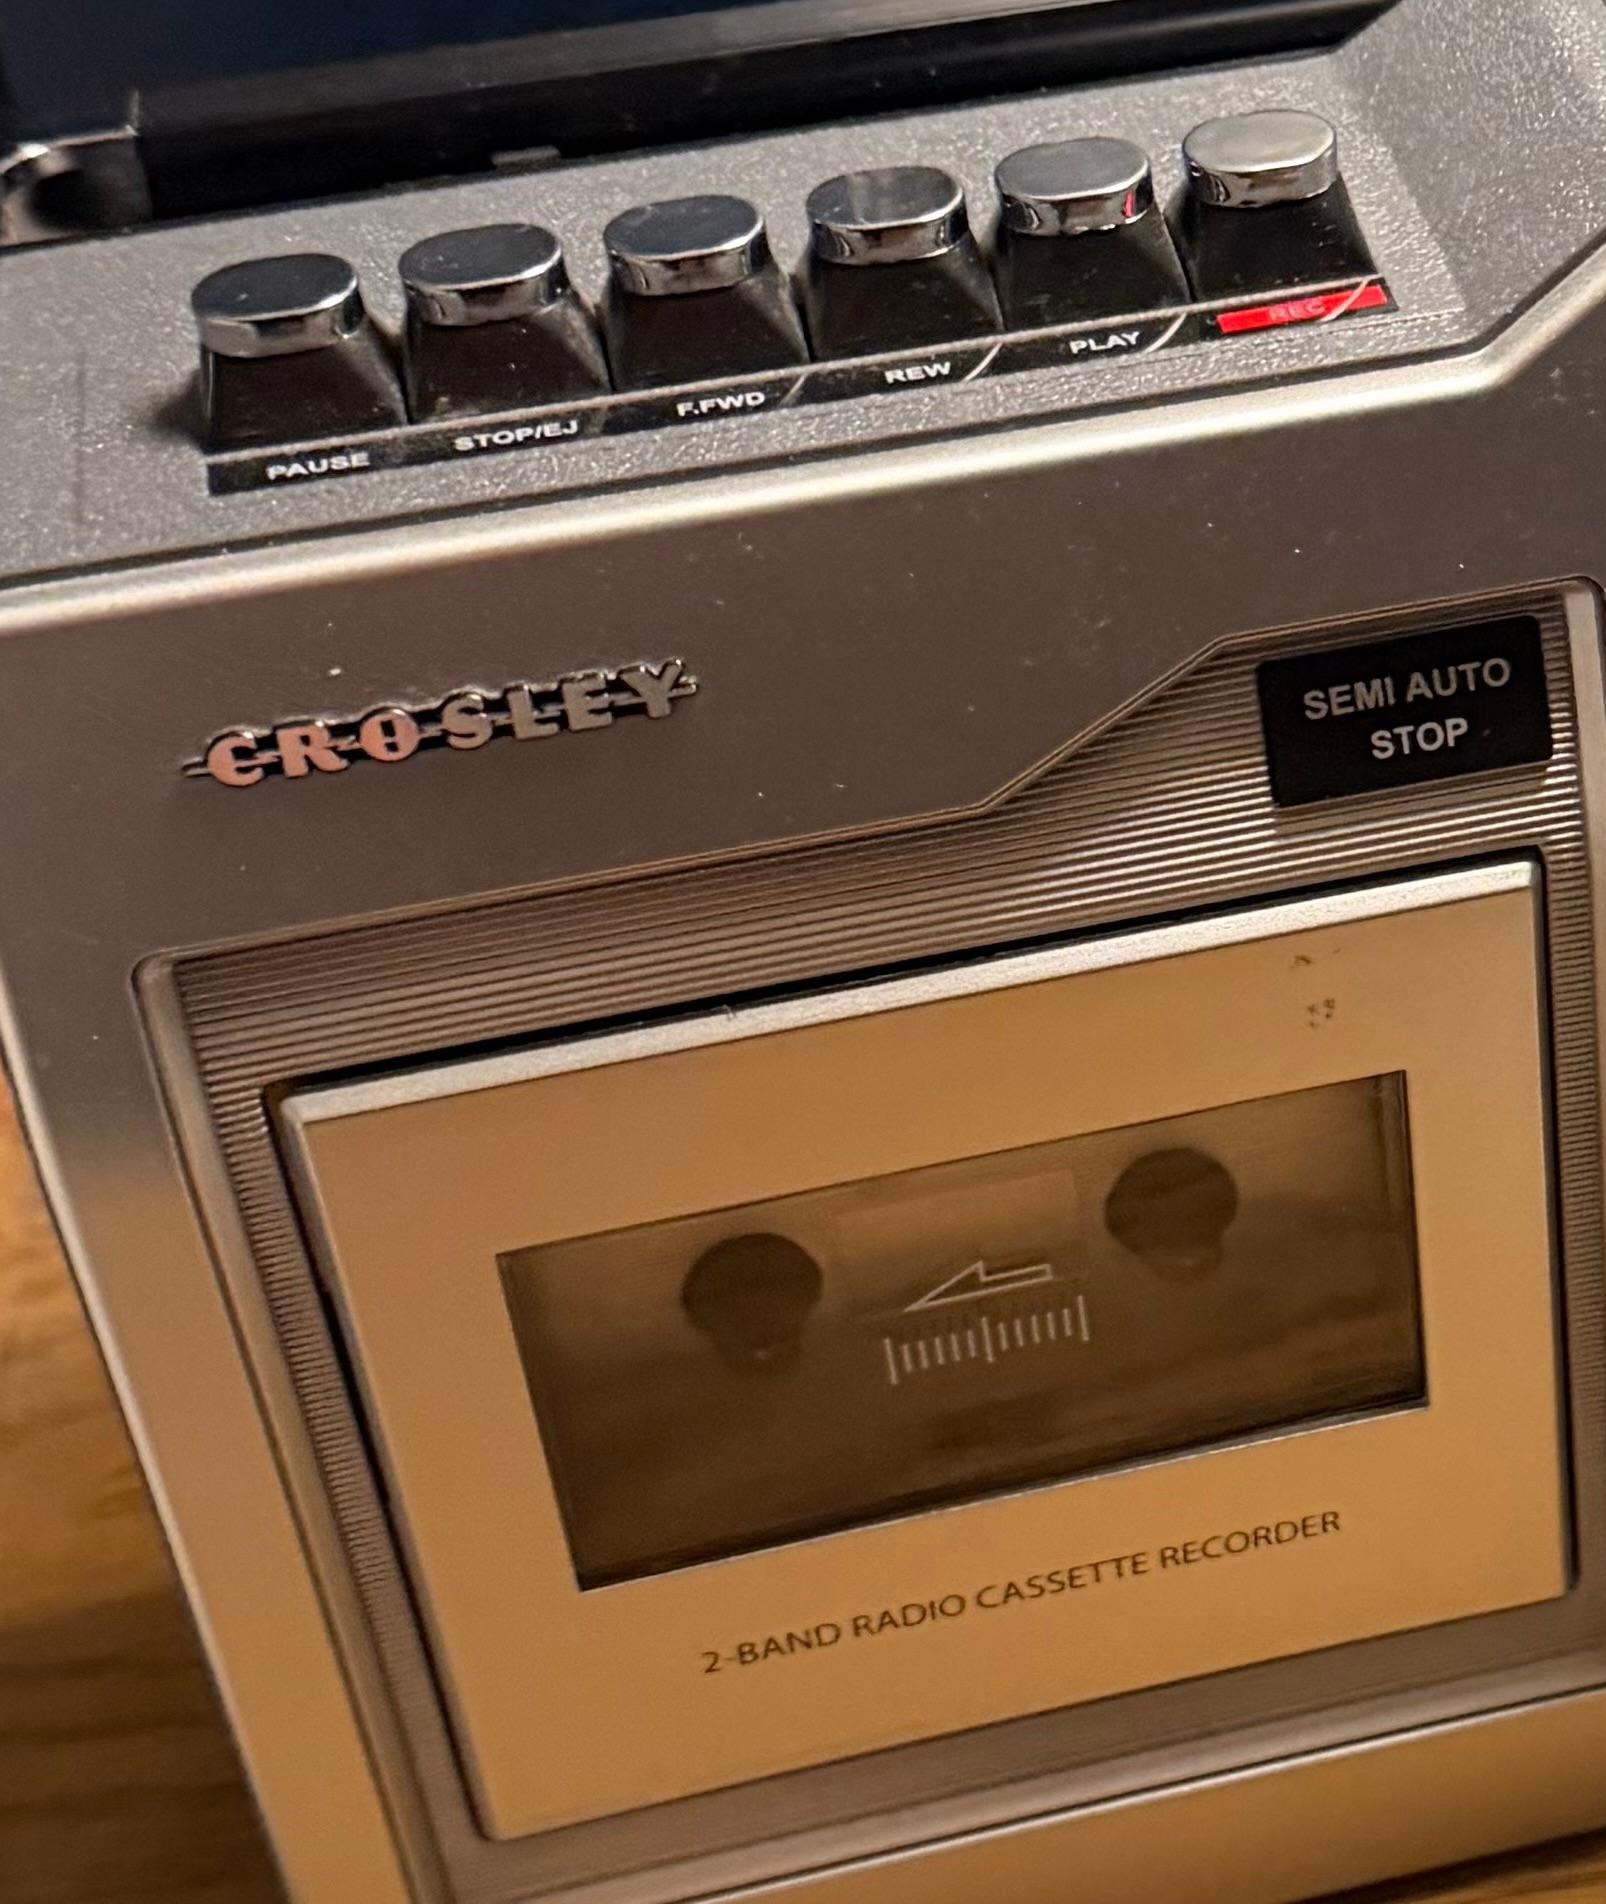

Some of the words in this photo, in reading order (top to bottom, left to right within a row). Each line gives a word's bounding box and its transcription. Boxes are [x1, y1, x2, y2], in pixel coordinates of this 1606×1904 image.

[1268, 296, 1327, 322] REC
[1067, 329, 1143, 356] PLAY
[884, 359, 953, 386] REW
[675, 390, 767, 419] F.FWD
[452, 418, 580, 454] STOP/EJ
[265, 450, 371, 483] PAUSE
[1302, 675, 1396, 721] SEMI
[1405, 656, 1512, 702] AUTO
[196, 657, 697, 788] CROSLEY
[1370, 716, 1470, 760] STOP
[701, 1621, 842, 1675] 2-BAND
[851, 1592, 968, 1639] RADIO
[975, 1550, 1150, 1610] CASSETTE
[1160, 1509, 1342, 1569] RECORDER
